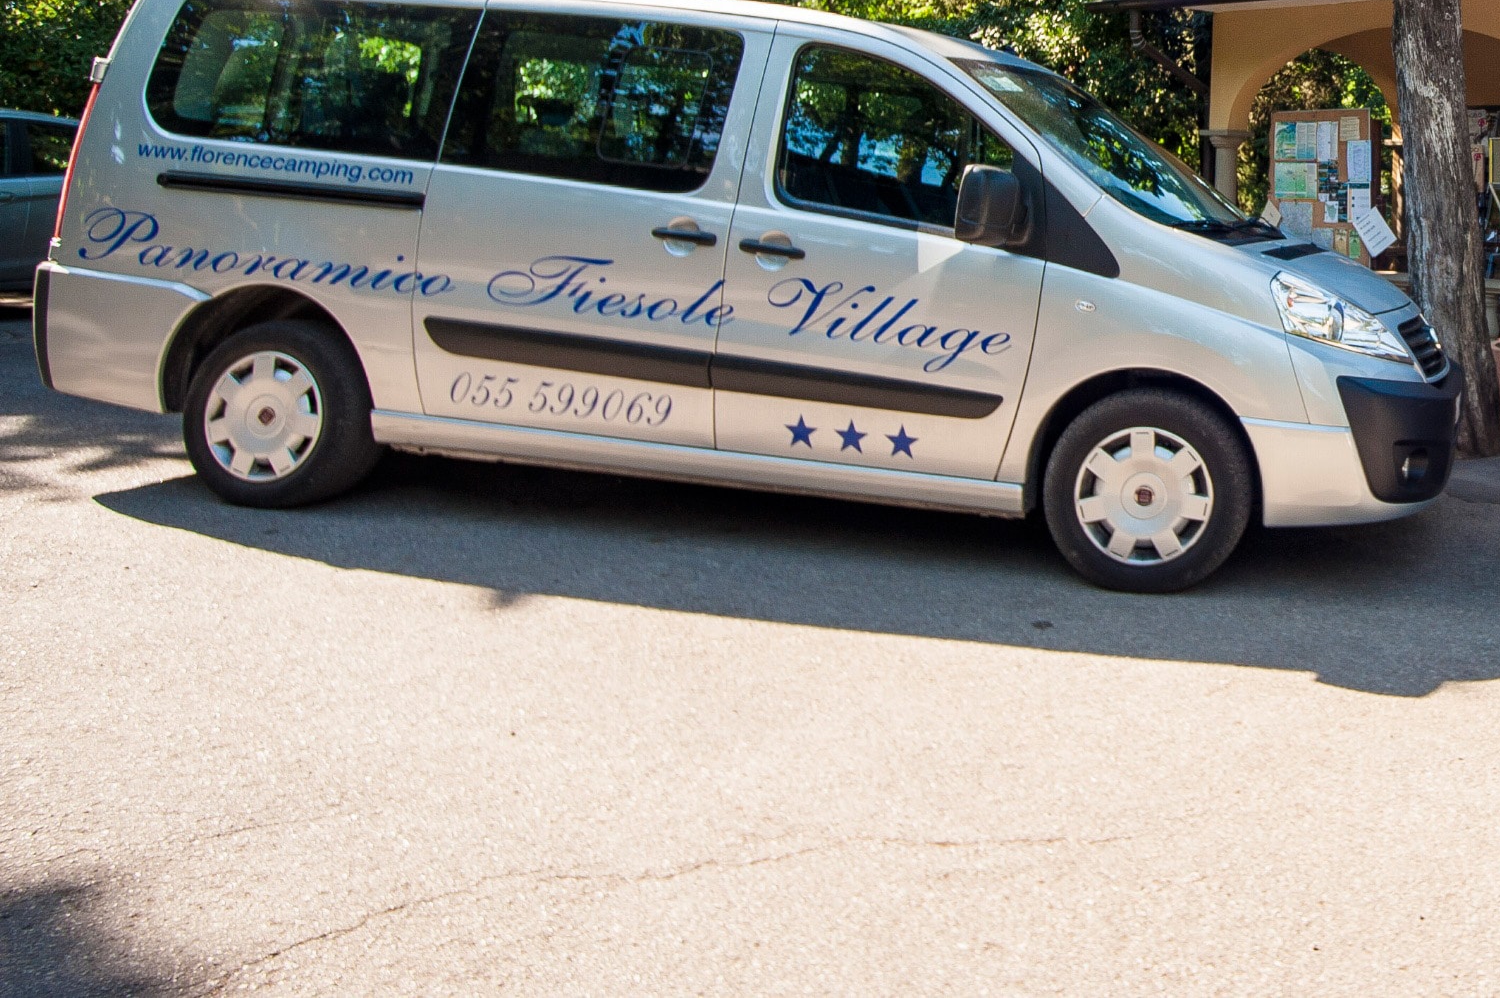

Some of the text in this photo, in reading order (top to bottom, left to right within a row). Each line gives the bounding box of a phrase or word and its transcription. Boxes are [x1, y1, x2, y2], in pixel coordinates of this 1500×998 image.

[137, 141, 414, 185] www.florencecamping.com
[78, 207, 1012, 373] Panoramico Fiesole Village
[450, 371, 673, 427] 055 599069
